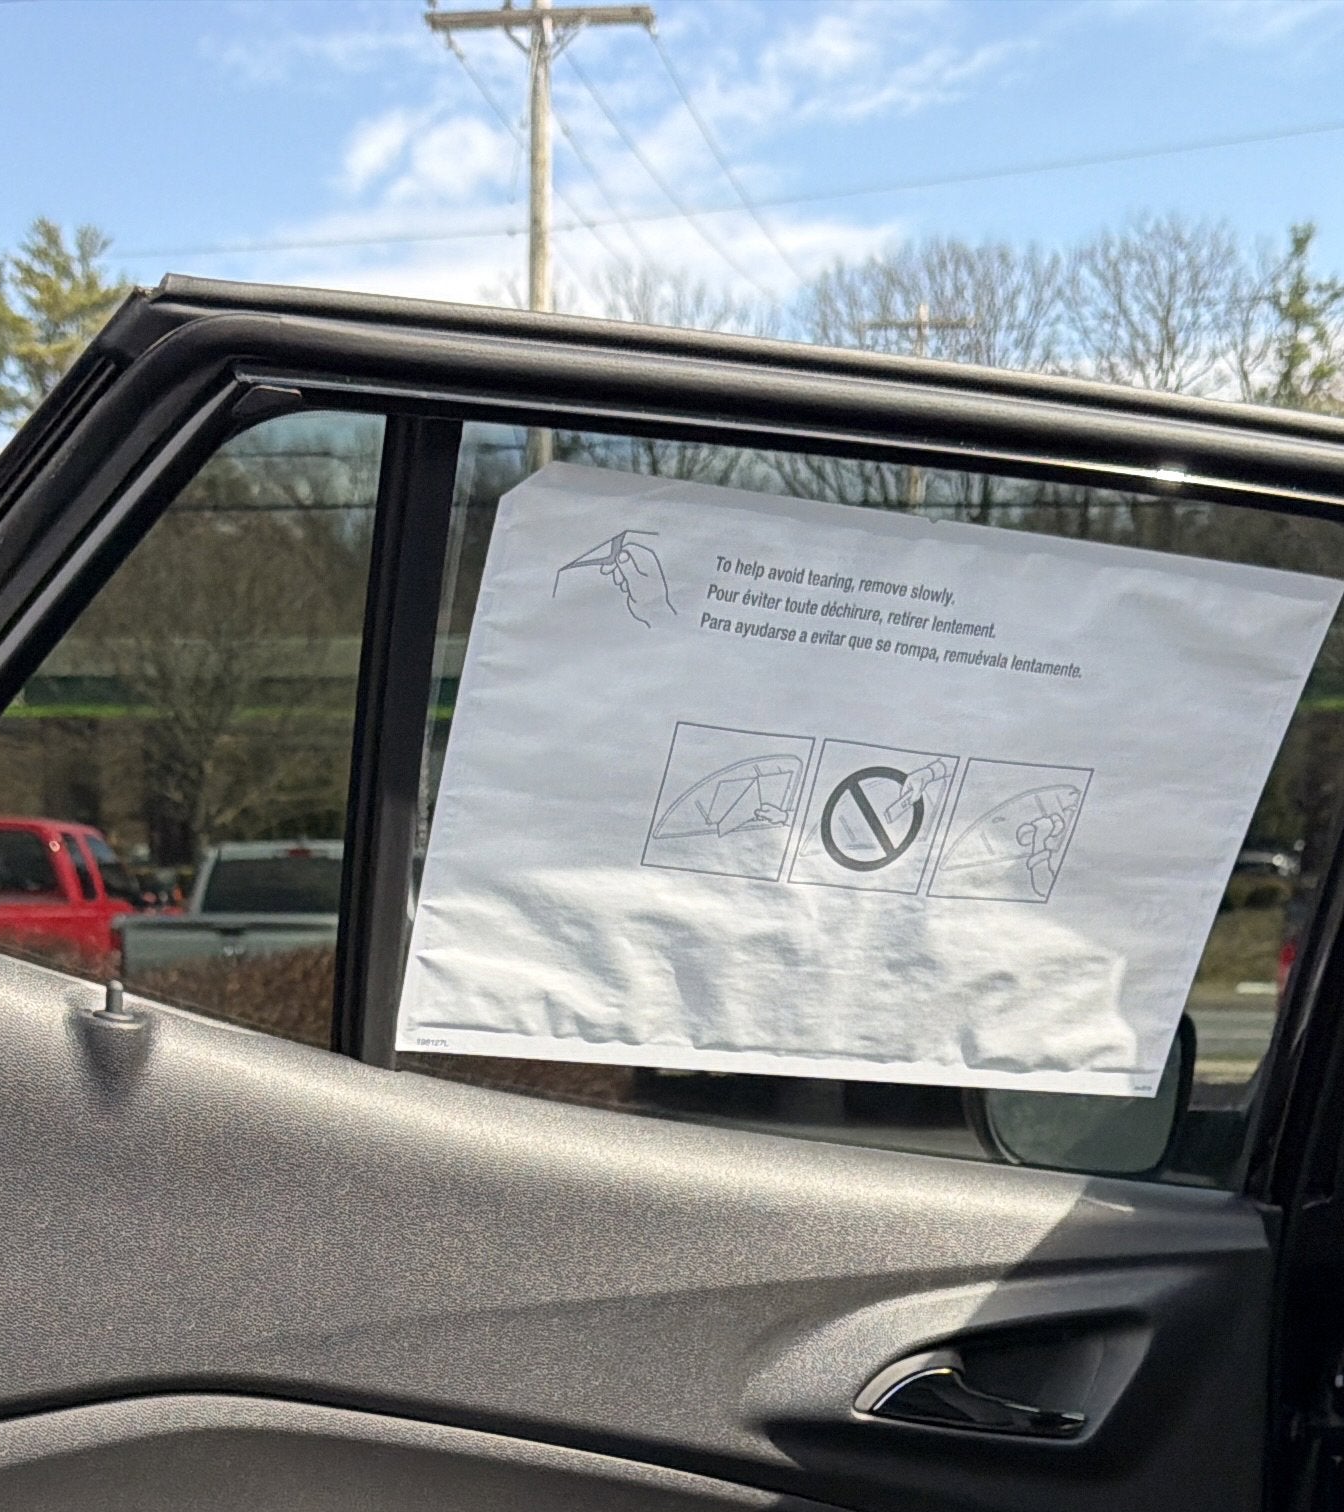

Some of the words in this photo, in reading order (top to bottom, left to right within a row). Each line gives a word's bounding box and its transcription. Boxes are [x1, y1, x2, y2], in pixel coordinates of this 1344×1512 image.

[717, 555, 731, 572] To
[735, 558, 764, 580] help
[768, 567, 805, 584] avoid
[808, 569, 855, 592] tearing,
[858, 578, 907, 597] remove
[910, 584, 955, 607] slowly.
[707, 584, 740, 603] Pour
[742, 588, 782, 610] éviter
[785, 597, 818, 615] toute
[821, 601, 883, 625] déchirure,
[887, 611, 930, 629] retirer
[931, 616, 996, 638] lentement.
[700, 612, 731, 632] Para
[735, 621, 796, 642] ayudarse
[799, 630, 807, 643] a
[810, 629, 846, 646] evitar
[848, 635, 872, 652] que
[877, 638, 892, 652] se
[894, 640, 939, 663] rompa,
[943, 650, 1007, 669] remuévala
[1010, 655, 1083, 679] lentamente.
